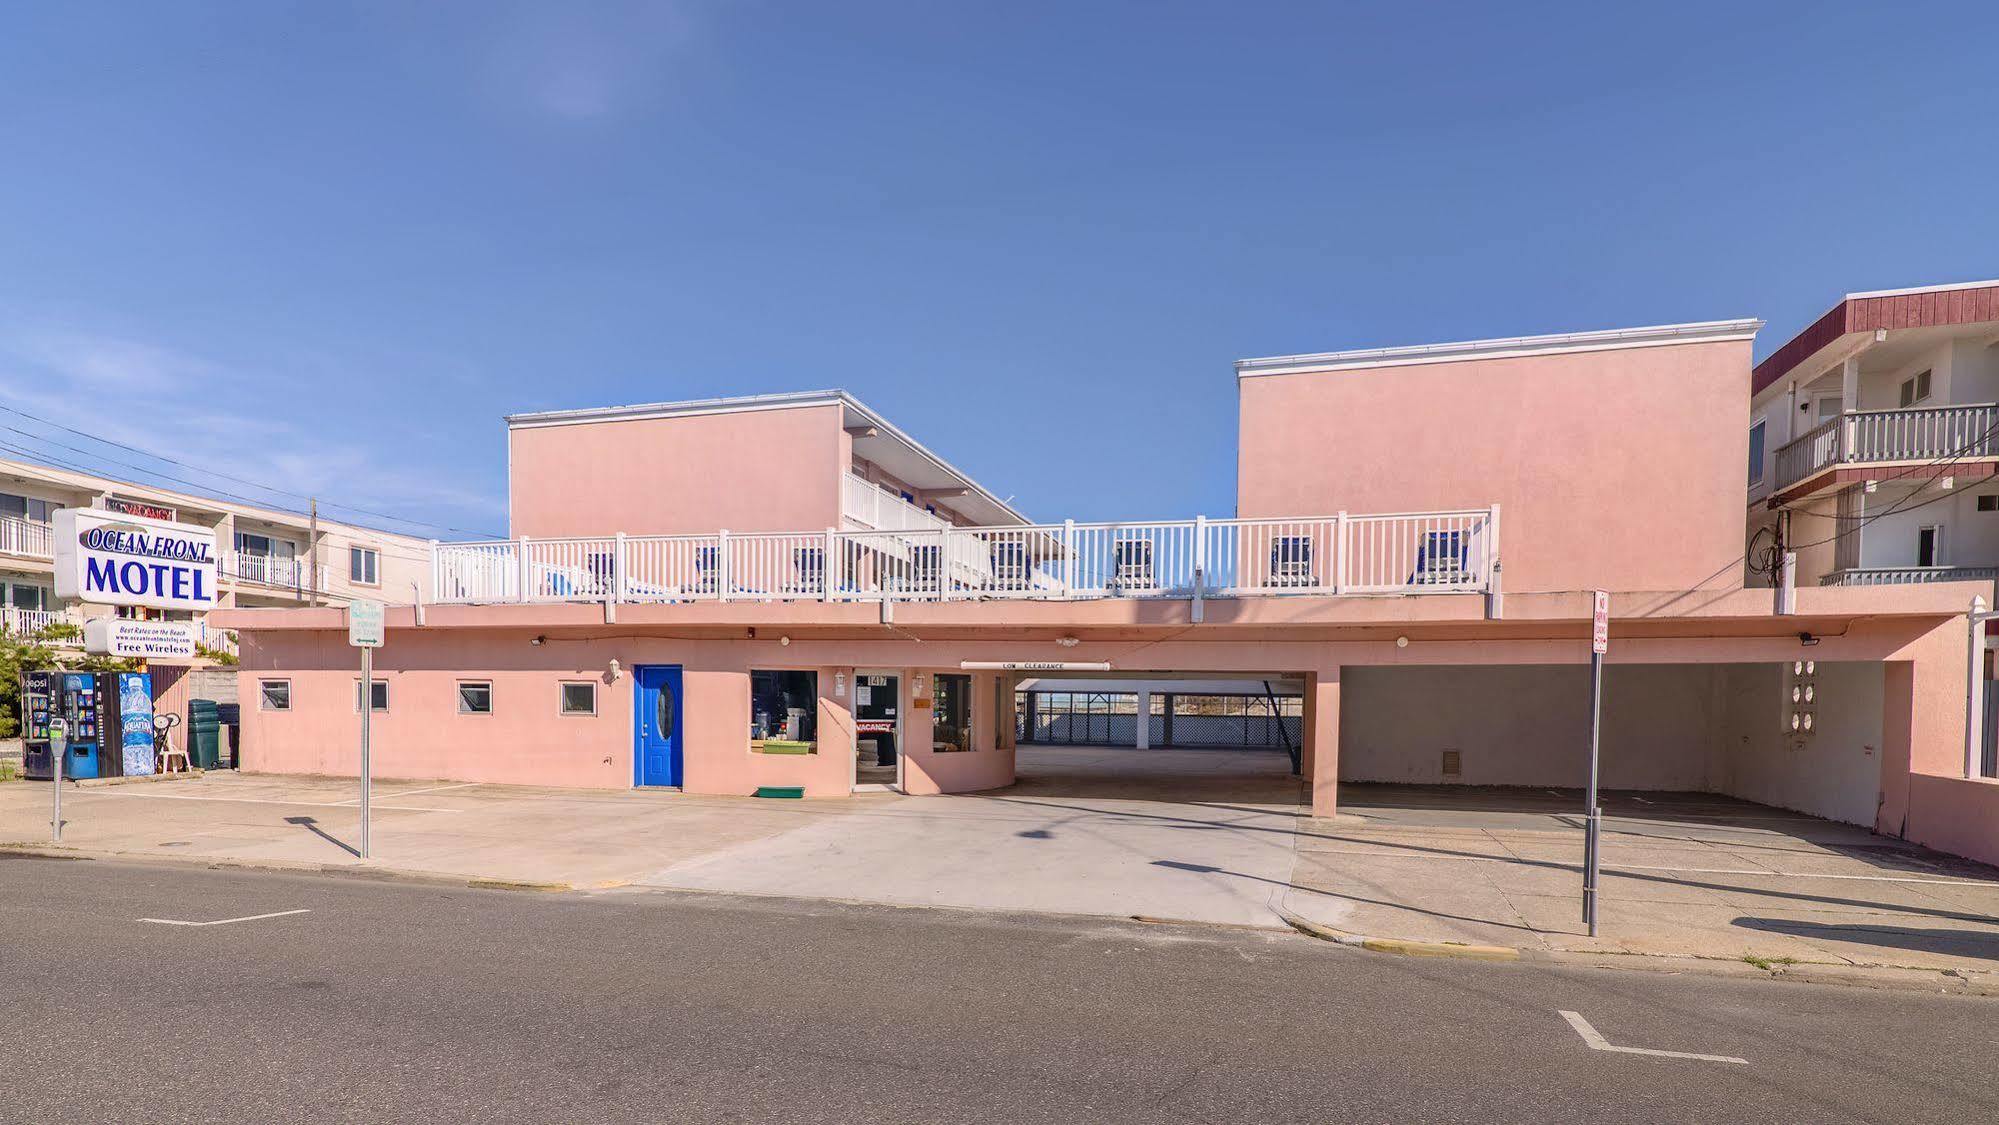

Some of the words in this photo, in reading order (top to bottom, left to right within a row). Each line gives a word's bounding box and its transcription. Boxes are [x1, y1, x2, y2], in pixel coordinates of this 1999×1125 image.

[88, 527, 150, 554] OCEAN
[153, 536, 210, 561] FRONT
[86, 557, 211, 601] MOTEL
[119, 626, 134, 634] Best
[134, 627, 151, 635] Rates
[170, 629, 186, 637] Beach
[117, 643, 141, 652] Free
[145, 644, 189, 654] Wireless
[25, 679, 47, 689] pepsi
[856, 723, 892, 732] VACANCY
